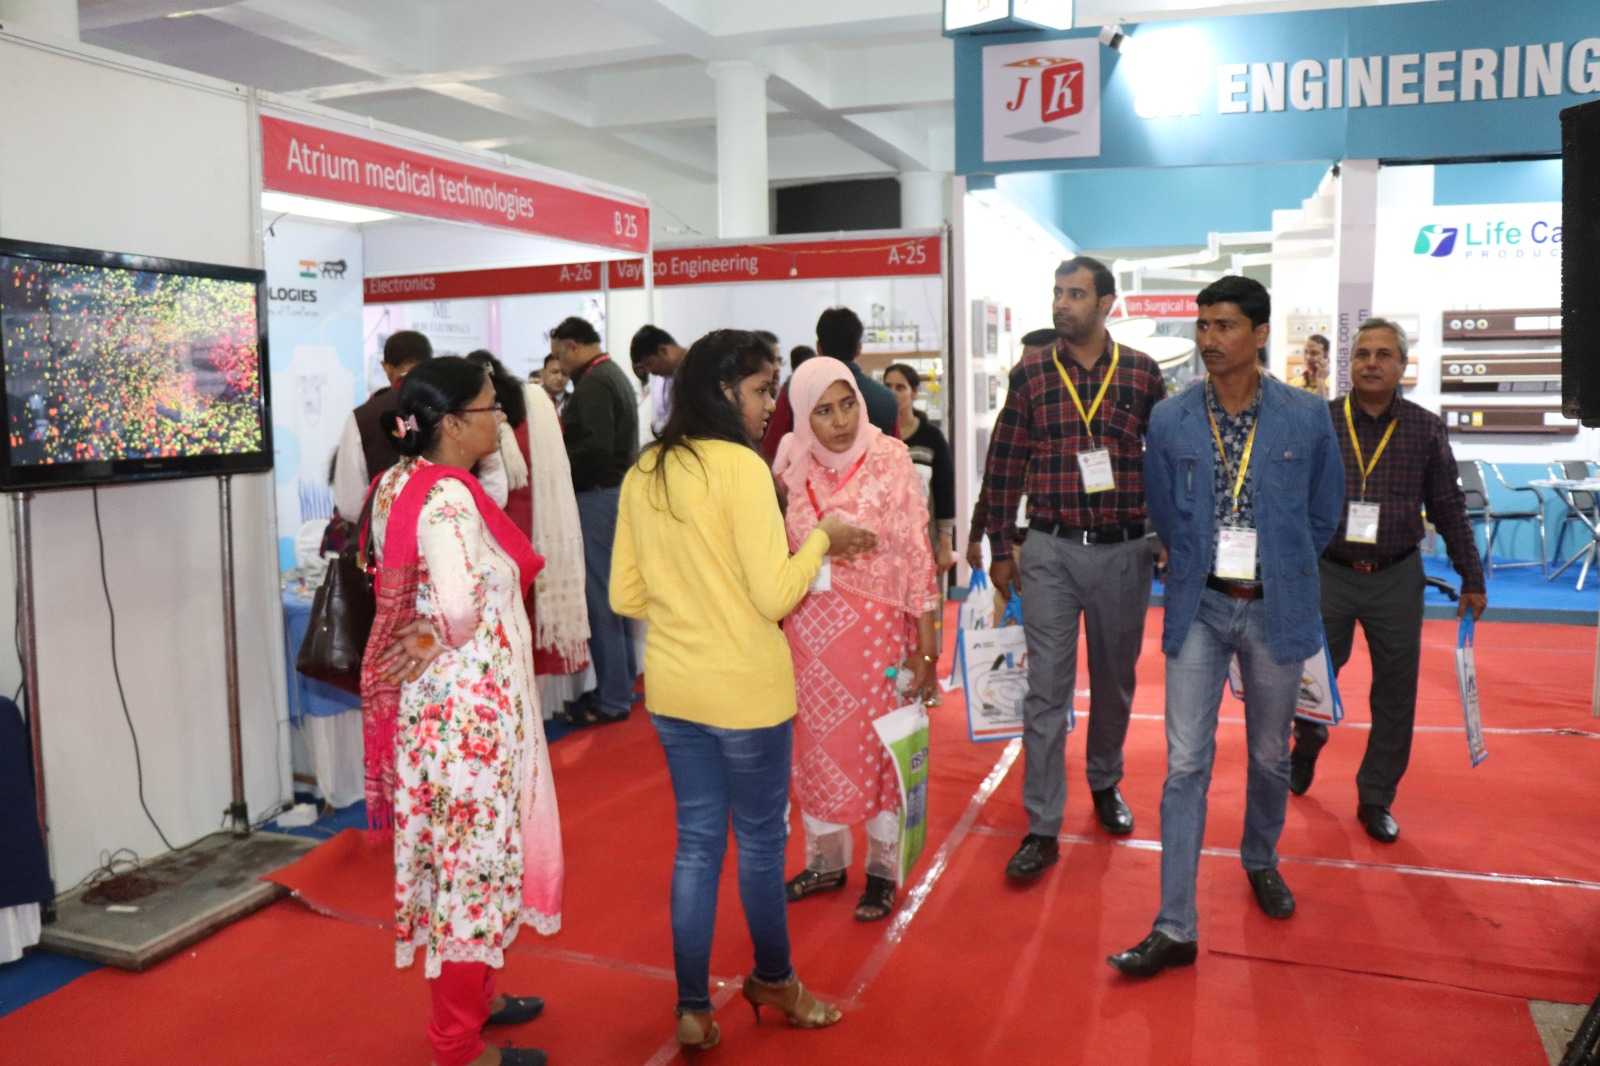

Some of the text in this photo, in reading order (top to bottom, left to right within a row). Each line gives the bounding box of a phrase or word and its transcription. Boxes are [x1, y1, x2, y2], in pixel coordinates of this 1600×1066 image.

[1216, 36, 1600, 114] ENGINEERING
[287, 137, 535, 222] Atrium medical technologies
[614, 210, 638, 238] B 25
[1466, 221, 1522, 246] Life
[671, 254, 759, 279] Engineering
[888, 244, 927, 266] A-25
[370, 275, 436, 295] Electronics
[560, 263, 593, 282] A-26
[1144, 299, 1184, 315] Surgical
